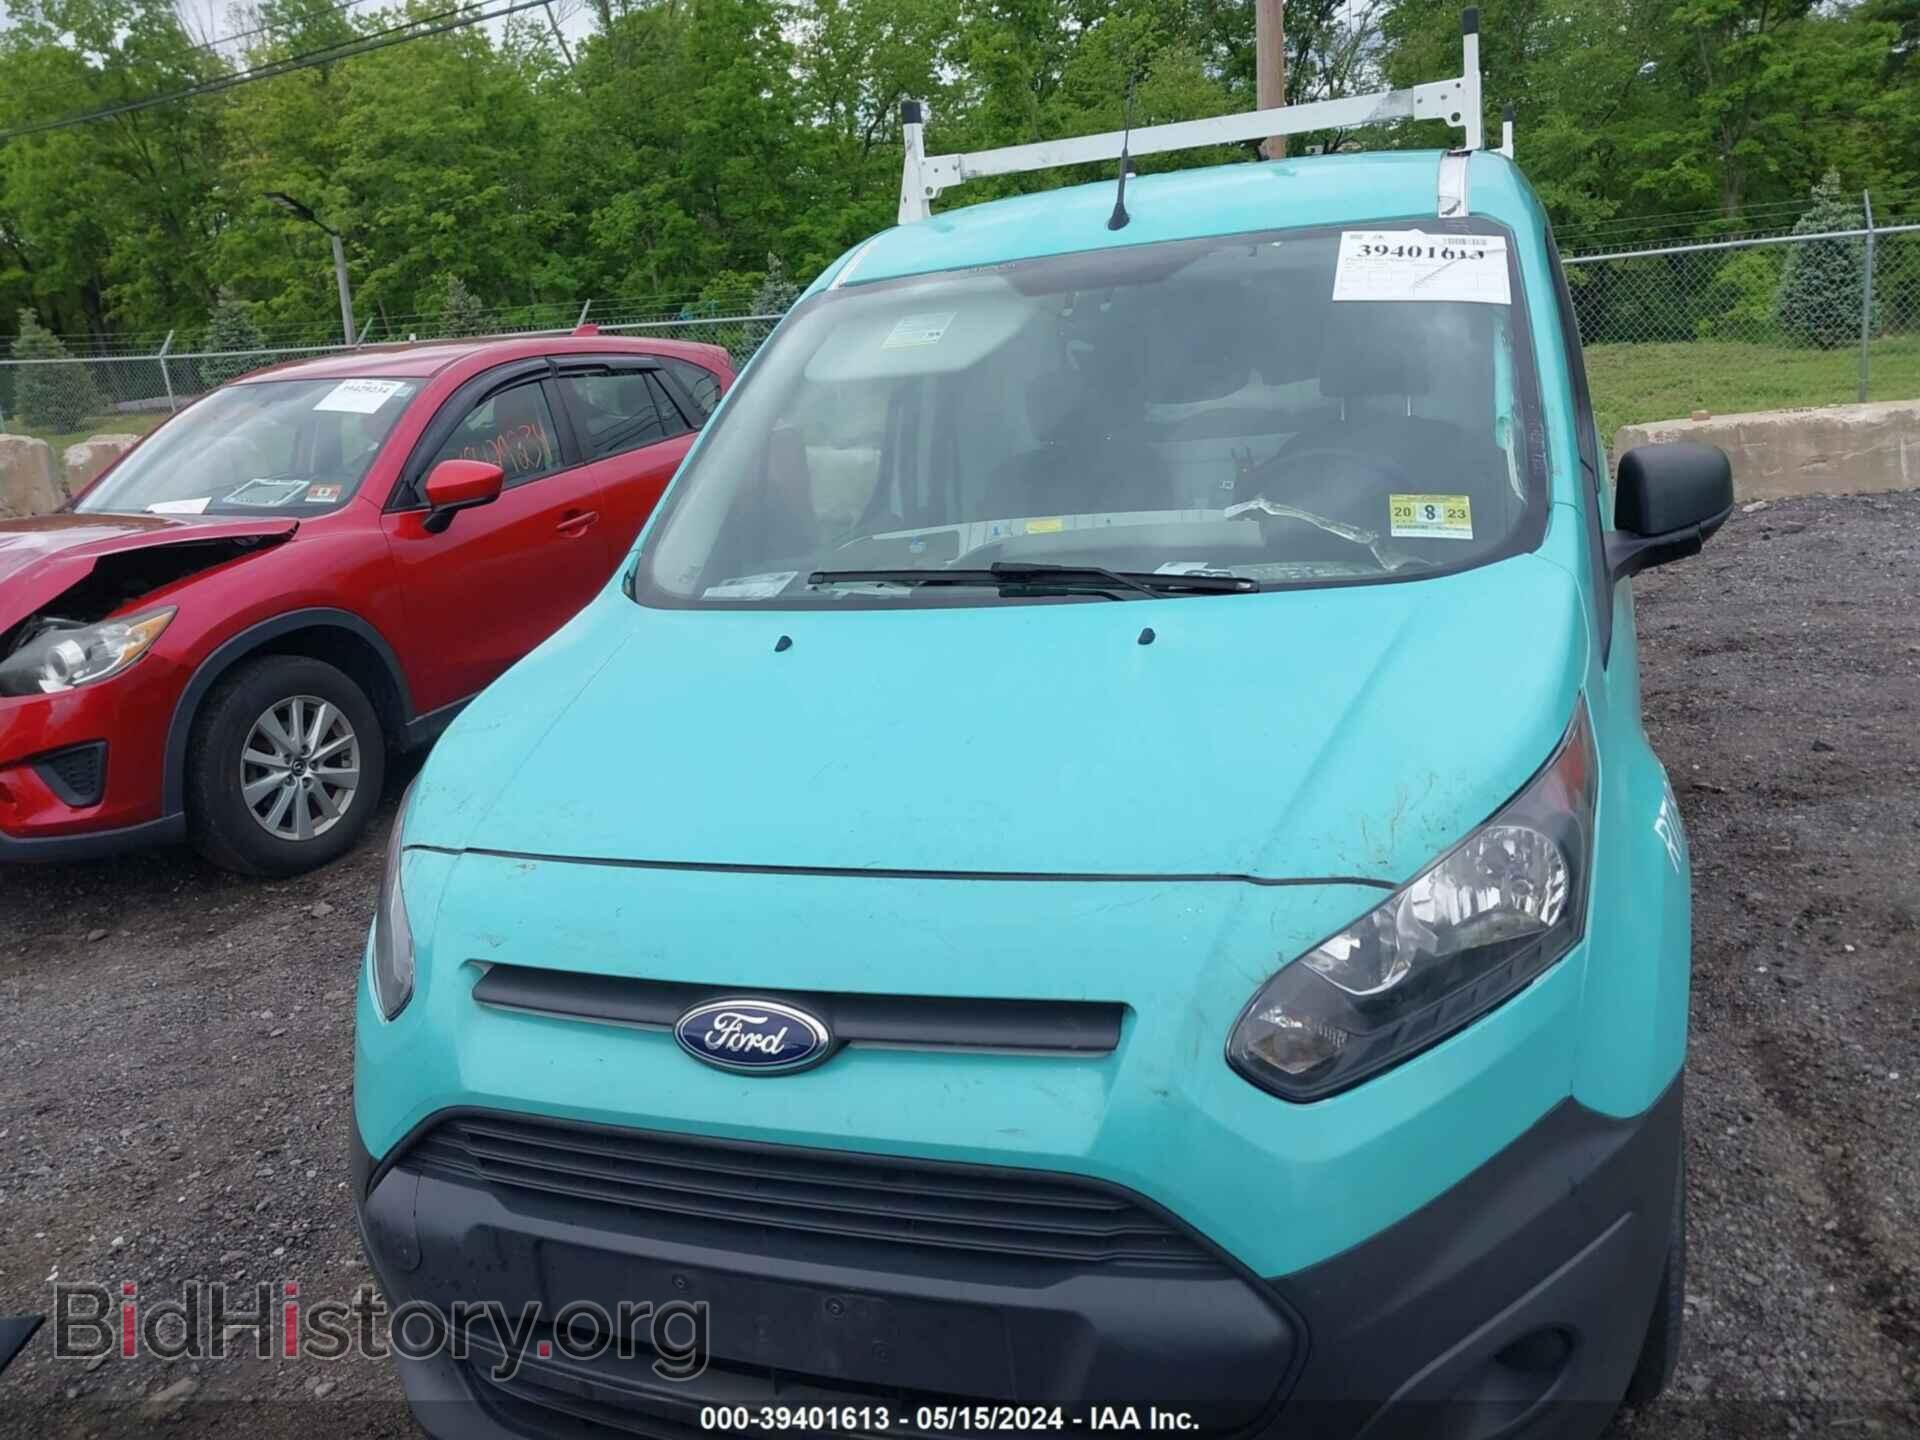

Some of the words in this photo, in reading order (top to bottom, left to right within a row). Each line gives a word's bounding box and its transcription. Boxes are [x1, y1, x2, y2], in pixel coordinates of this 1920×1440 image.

[1394, 507, 1412, 517] 20
[1424, 504, 1436, 520] 8
[1448, 508, 1466, 519] 23
[704, 1011, 789, 1056] Ford
